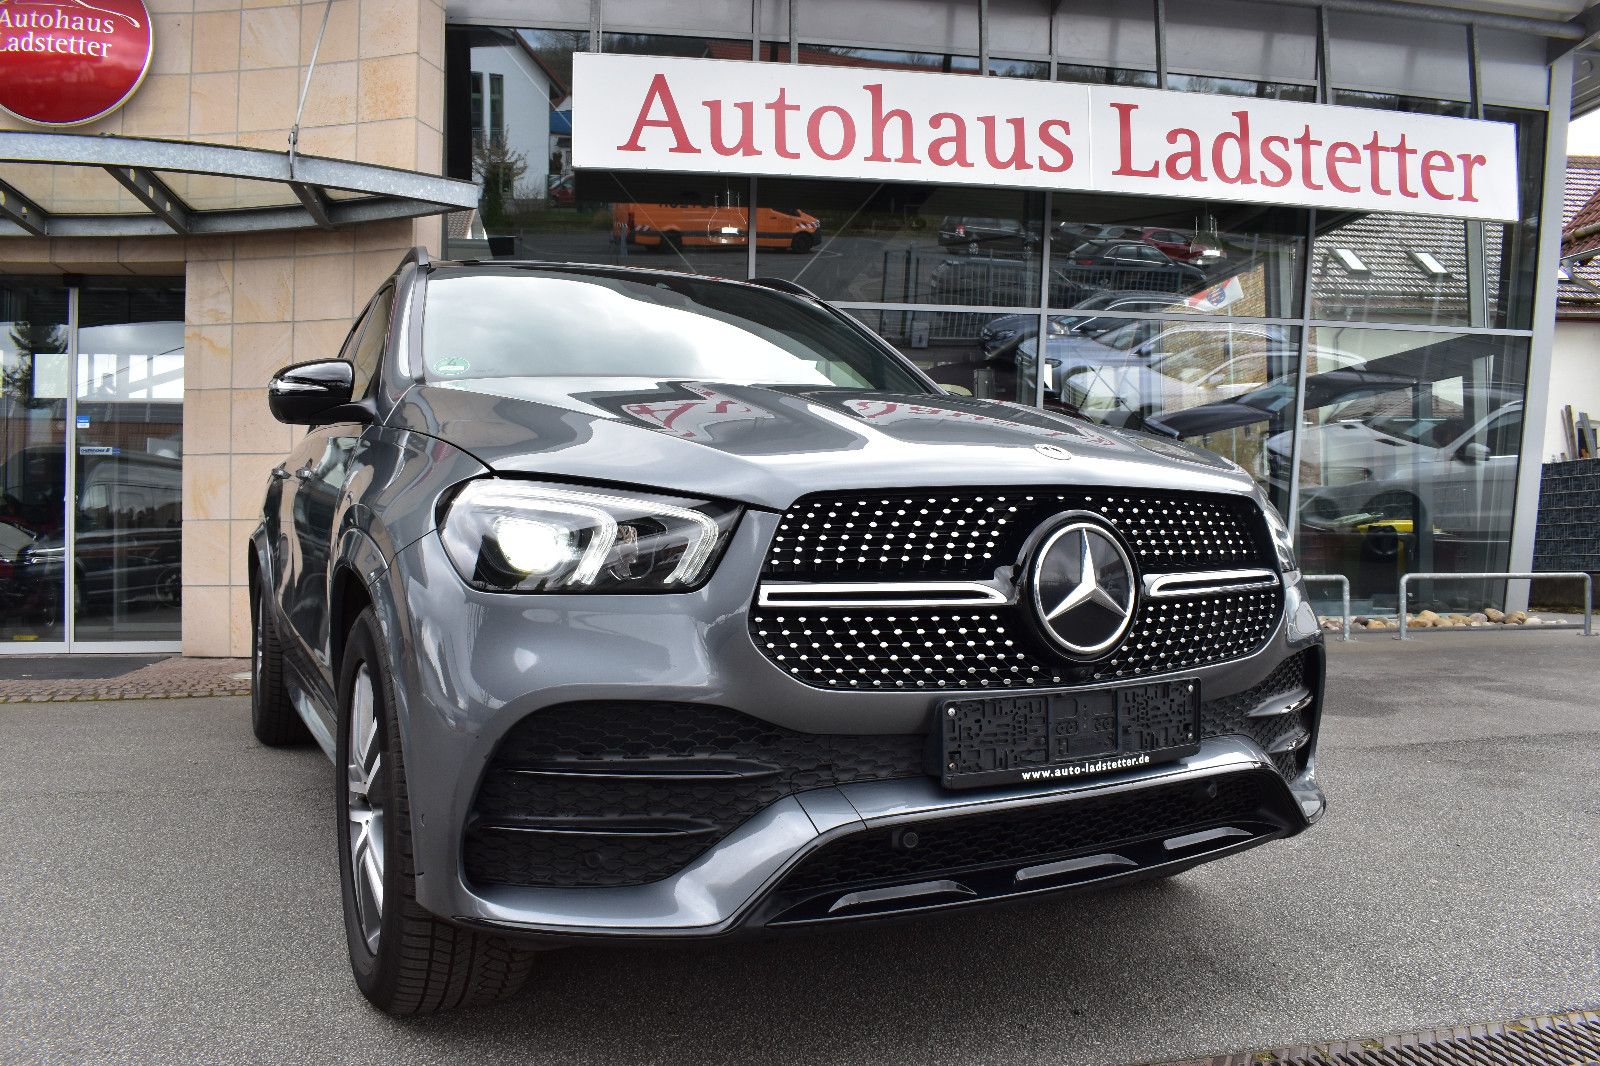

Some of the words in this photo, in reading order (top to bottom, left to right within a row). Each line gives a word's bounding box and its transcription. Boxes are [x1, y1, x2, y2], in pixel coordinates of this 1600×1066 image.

[0, 9, 114, 34] Autohaus
[616, 73, 1074, 173] Autohaus
[1109, 102, 1487, 203] Ladstetter
[1021, 753, 1150, 780] www.auto-ladstetter.de
